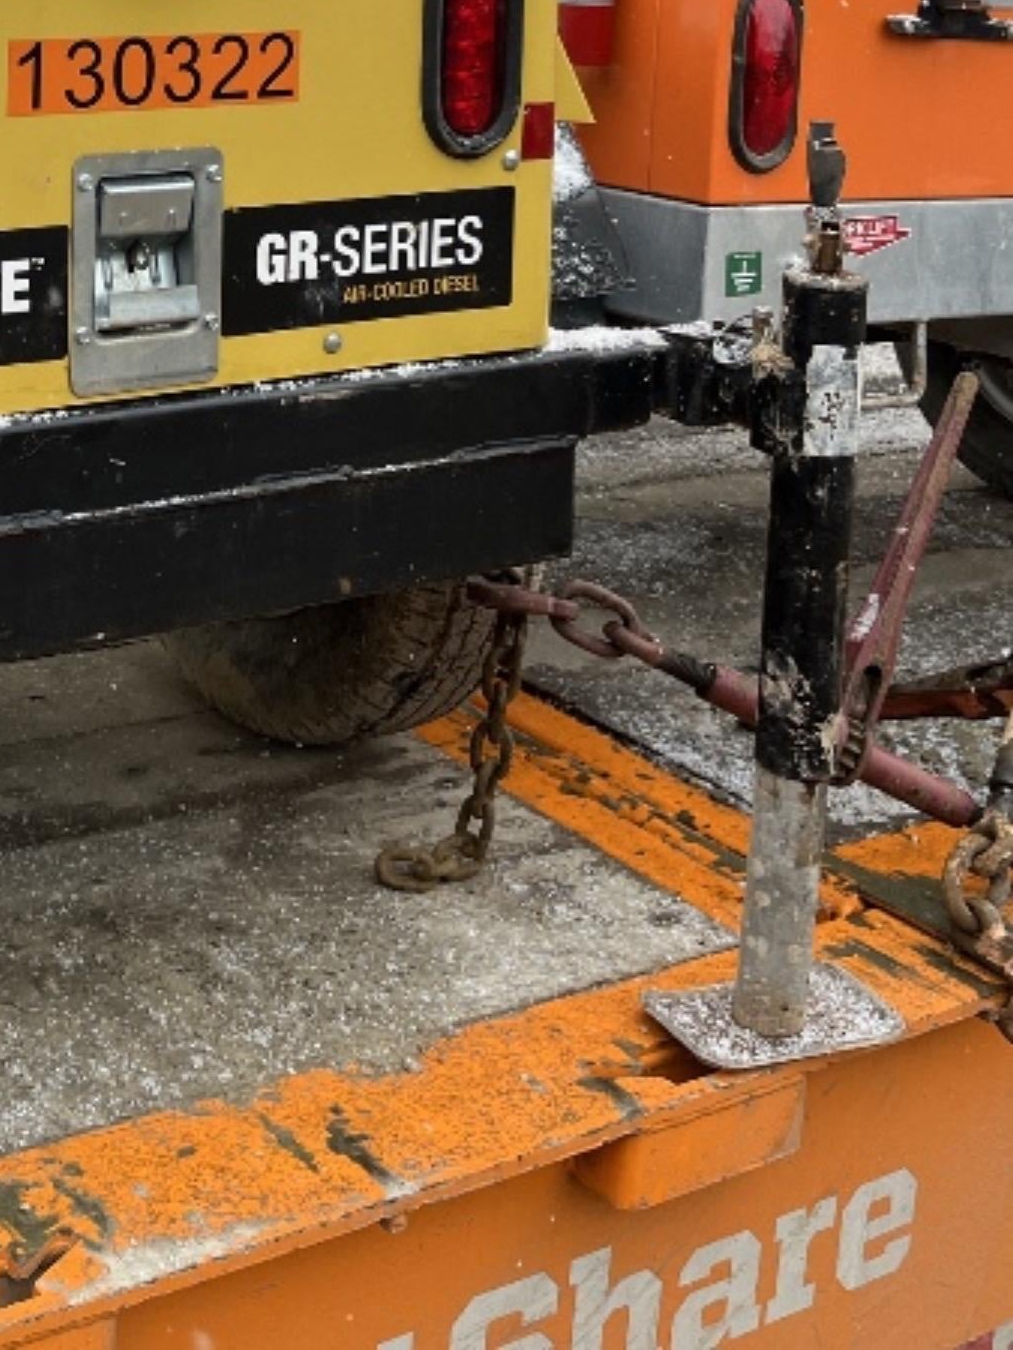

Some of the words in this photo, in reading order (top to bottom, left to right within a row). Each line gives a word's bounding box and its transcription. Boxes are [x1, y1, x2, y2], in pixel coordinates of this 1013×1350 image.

[17, 32, 295, 109] 130322
[256, 214, 484, 285] GR-SERIES
[343, 279, 429, 304] AIR-COOLED
[433, 274, 480, 296] DIESEL
[377, 1166, 919, 1350] Share
